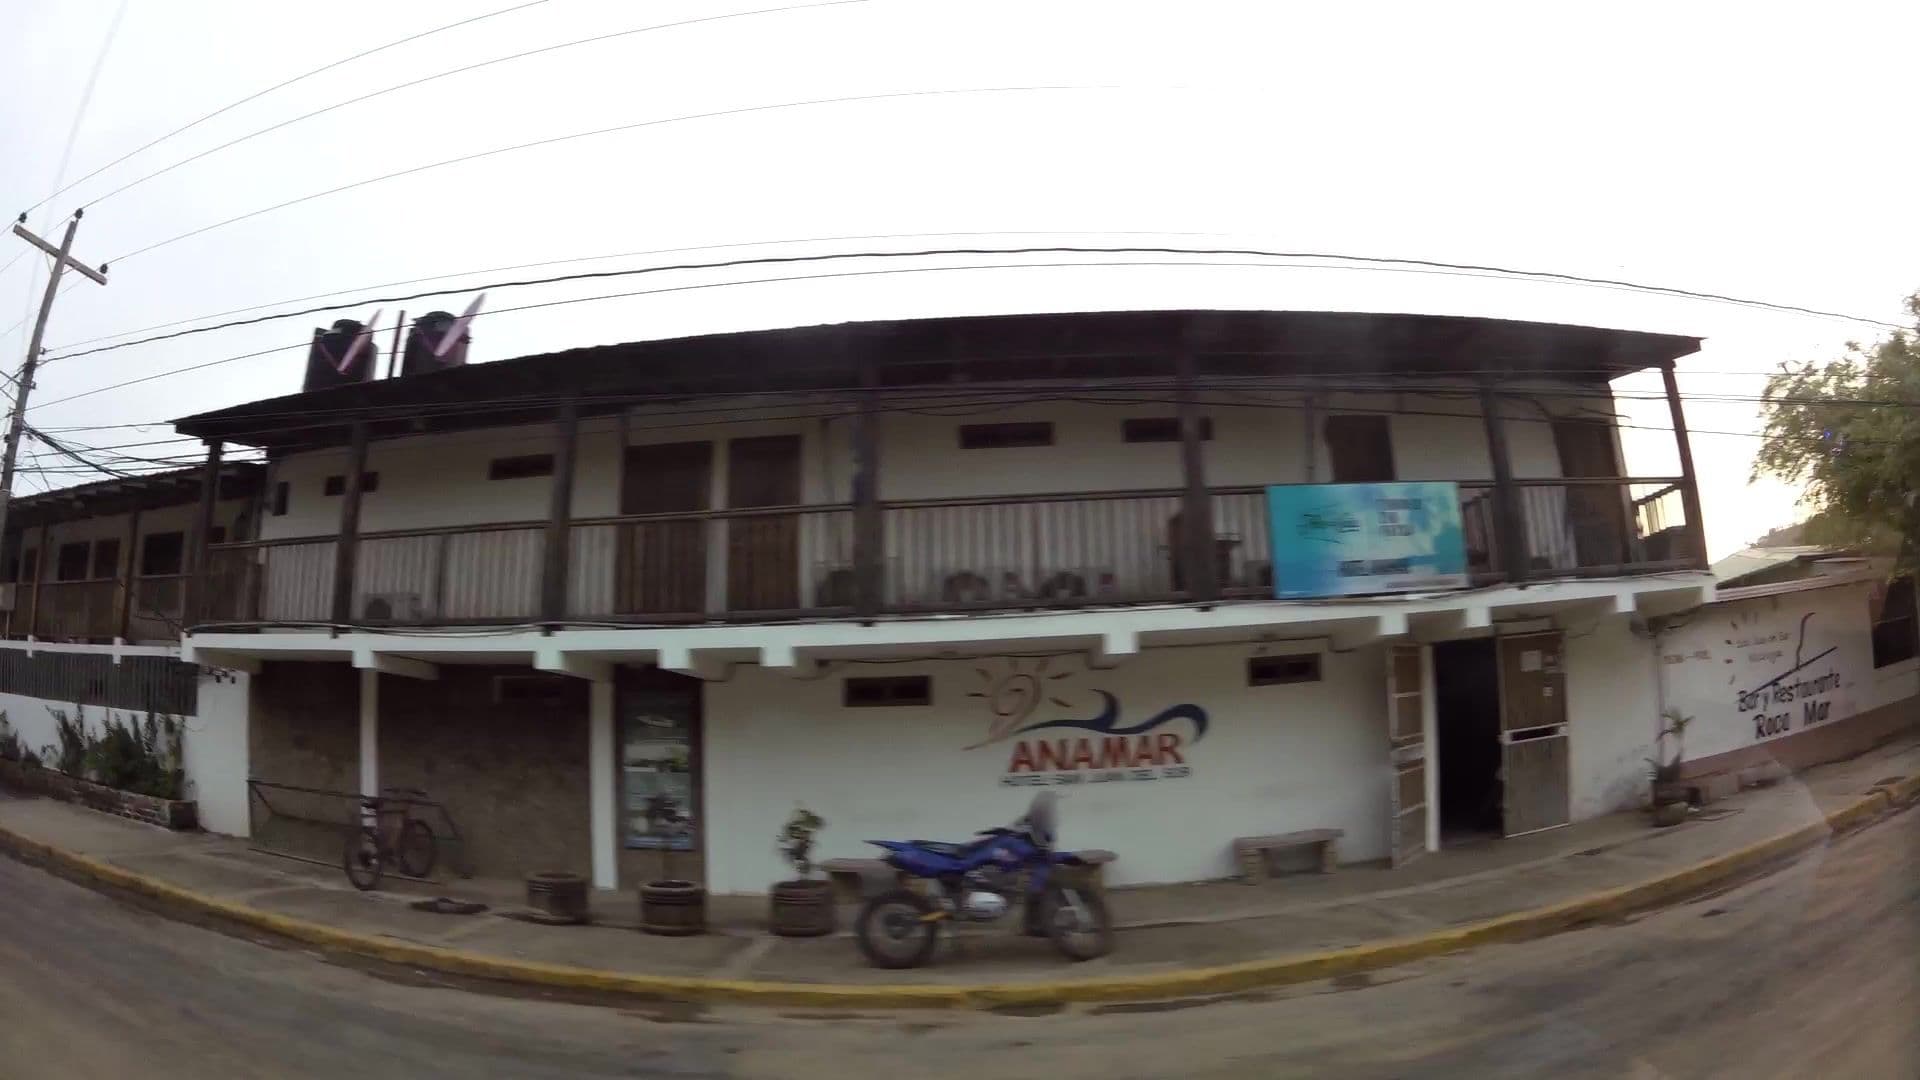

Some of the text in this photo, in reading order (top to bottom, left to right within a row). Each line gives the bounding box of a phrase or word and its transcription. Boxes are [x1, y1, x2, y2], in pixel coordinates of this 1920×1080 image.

[1737, 690, 1759, 712] Bar
[1772, 669, 1840, 704] Restaurante
[1803, 700, 1831, 726] Mar
[1007, 733, 1185, 773] ANAMAR
